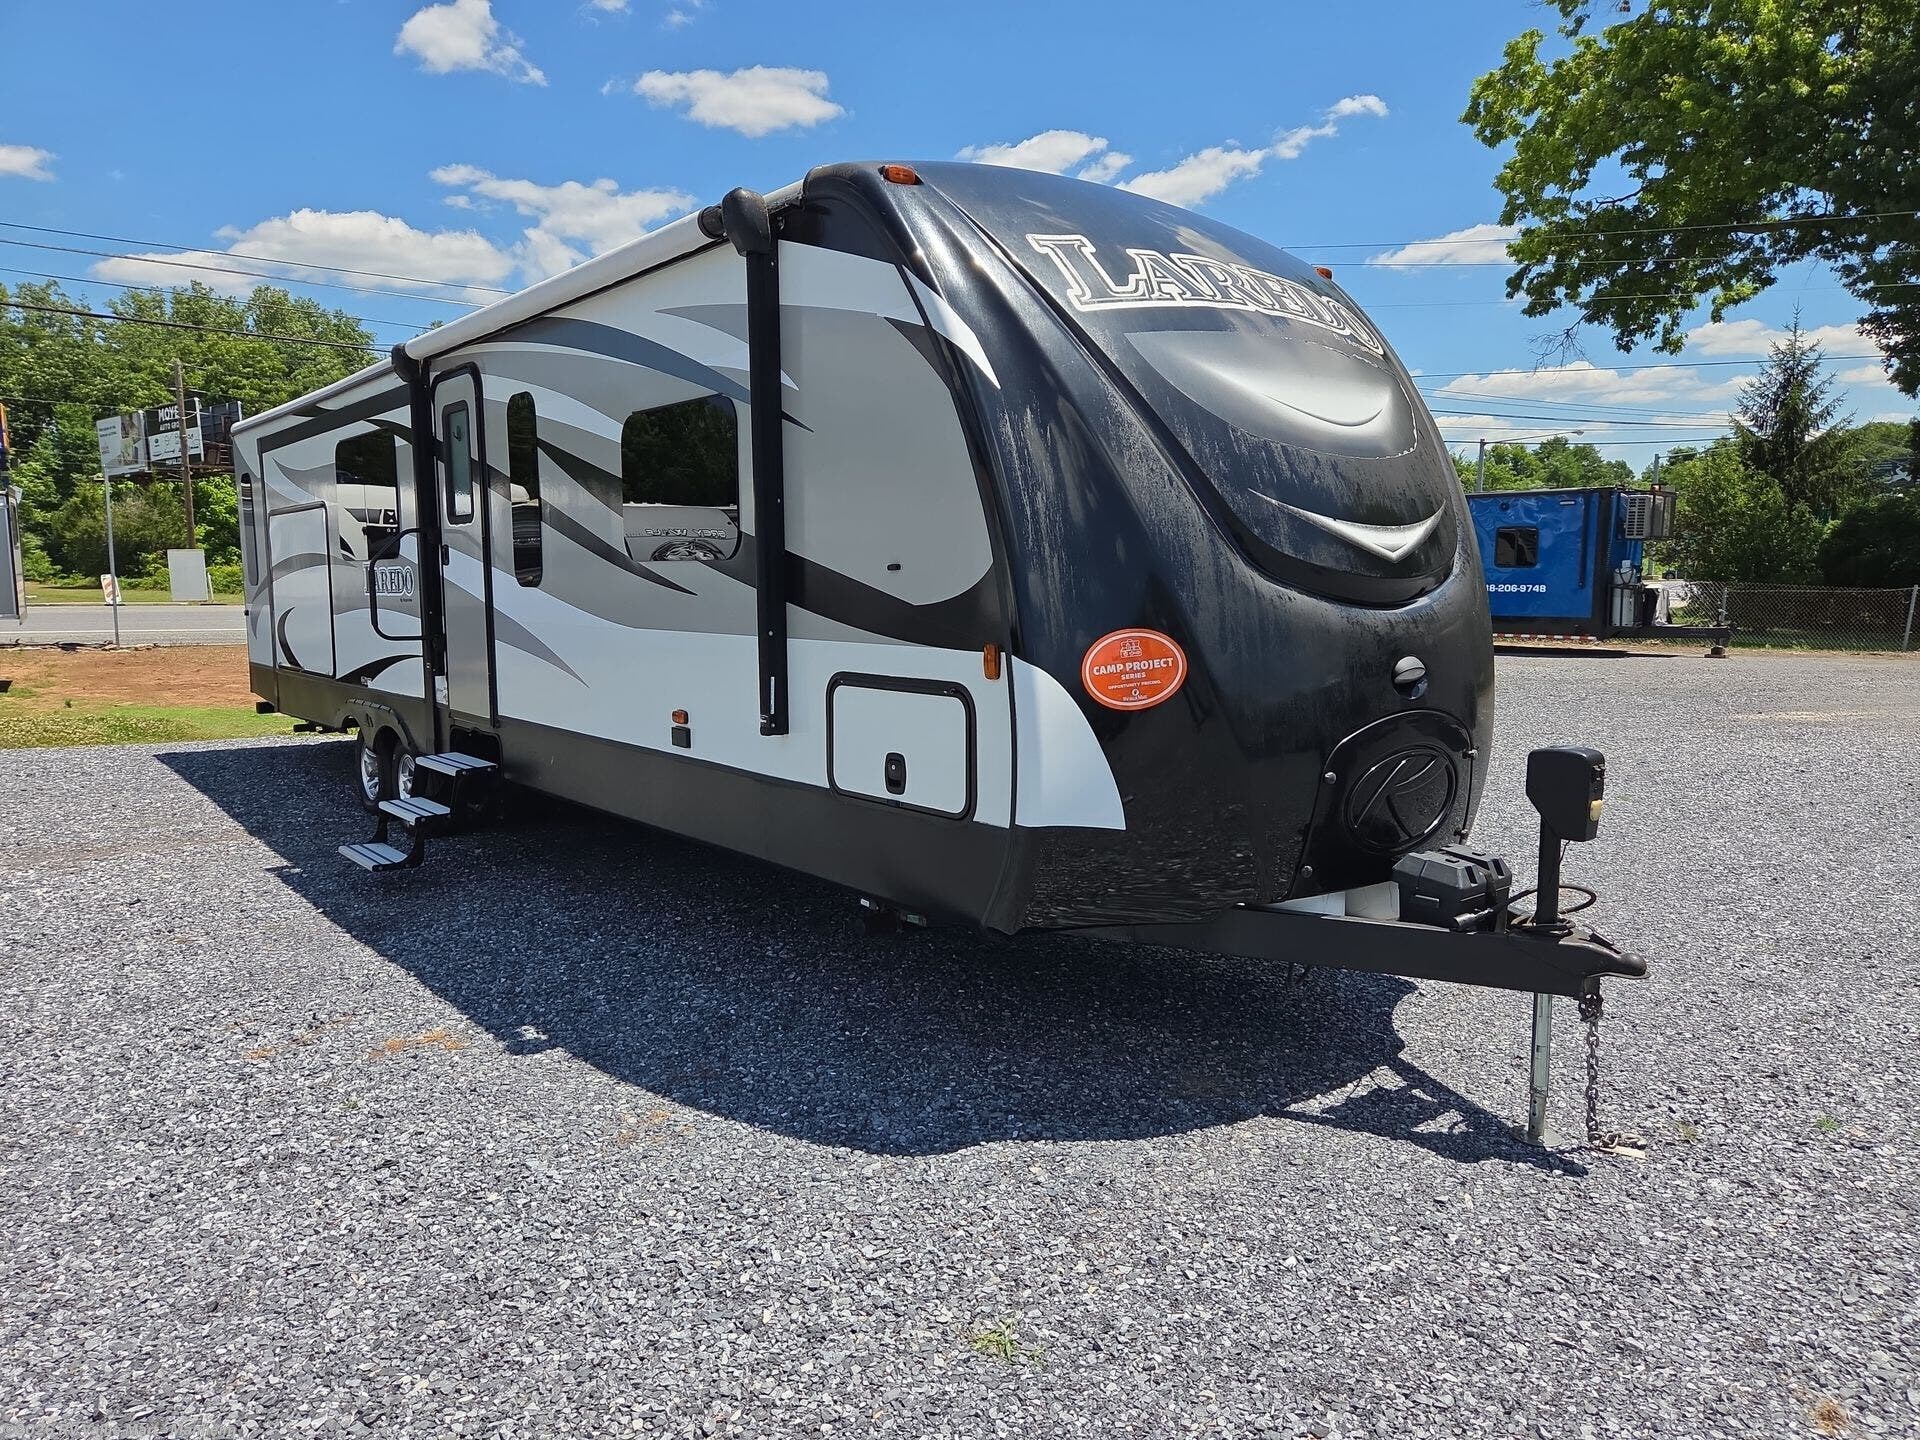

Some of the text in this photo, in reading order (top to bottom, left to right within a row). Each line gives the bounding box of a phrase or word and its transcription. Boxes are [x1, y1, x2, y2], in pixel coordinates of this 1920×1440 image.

[1025, 233, 1384, 355] LAREDO
[158, 405, 180, 422] MOYE
[1093, 657, 1174, 676] CAMP PROJECT
[1120, 671, 1147, 681] SERIES
[1107, 681, 1141, 690] OPPORTUNITY
